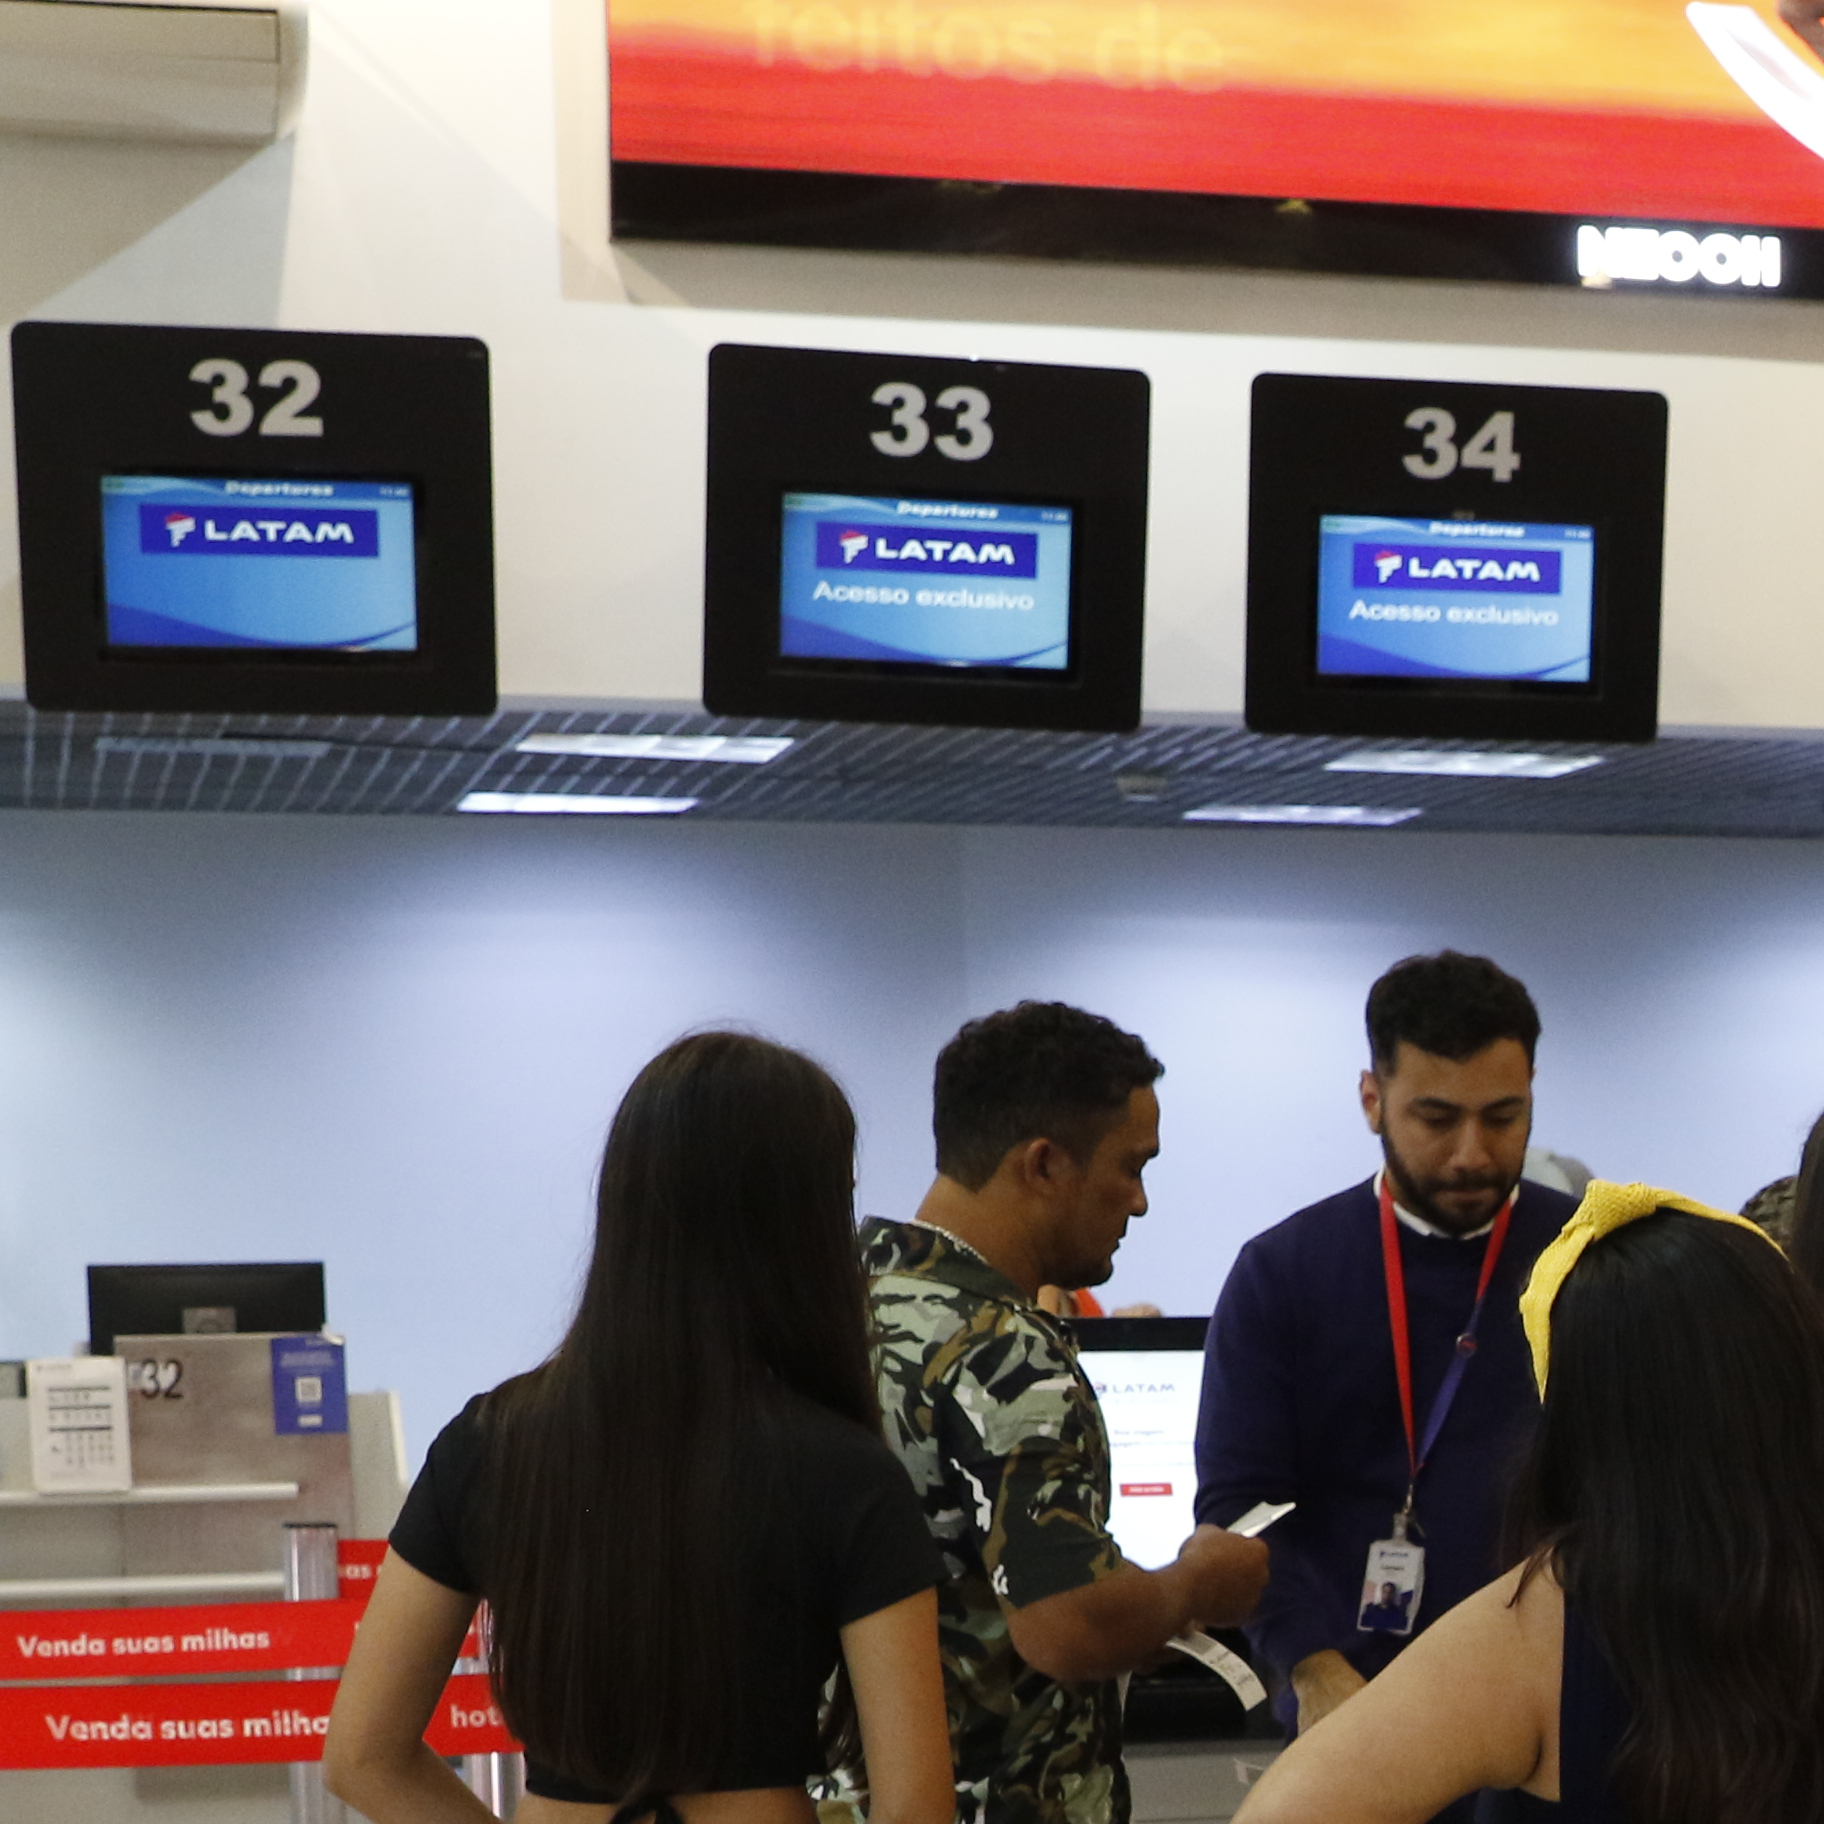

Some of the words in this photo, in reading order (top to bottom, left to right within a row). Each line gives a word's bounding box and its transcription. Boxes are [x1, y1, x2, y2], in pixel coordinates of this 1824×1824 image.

[188, 358, 324, 437] 32
[869, 379, 995, 462] 33
[1403, 406, 1520, 483] 34
[204, 519, 354, 544] LATAM
[875, 538, 1016, 566] LATAM
[1408, 556, 1541, 582] LATAM
[812, 580, 909, 605] Acesso
[915, 586, 1035, 612] exclusivo
[1348, 599, 1442, 623] Acesso
[1446, 604, 1560, 626] exclusivo
[140, 1358, 184, 1399] 32
[1112, 1383, 1176, 1394] LATAM
[16, 1634, 107, 1658] Venda
[112, 1632, 175, 1656] suas
[181, 1627, 270, 1653] milhas
[45, 1713, 153, 1742] Venda
[160, 1714, 234, 1741] suas
[243, 1710, 330, 1738] milha
